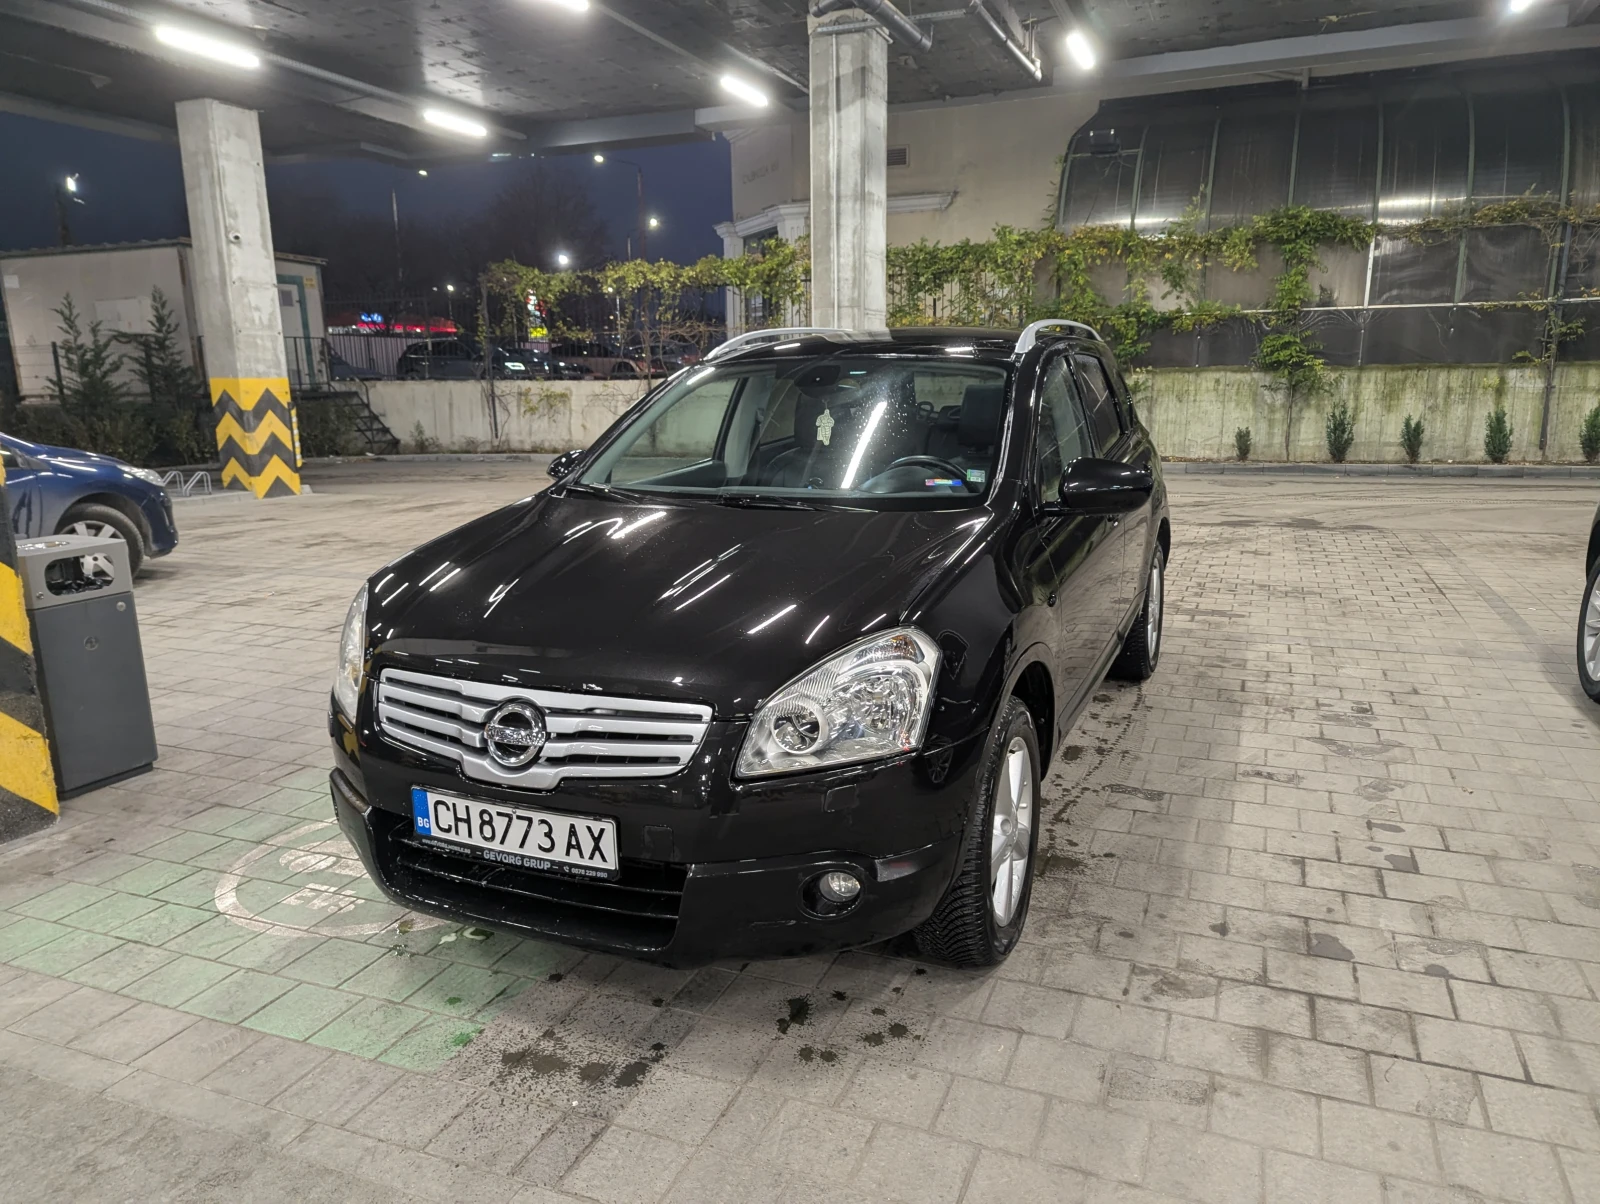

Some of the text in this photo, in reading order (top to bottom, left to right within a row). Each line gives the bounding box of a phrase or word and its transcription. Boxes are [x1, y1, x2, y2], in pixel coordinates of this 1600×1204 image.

[417, 816, 430, 829] BG
[433, 799, 608, 863] CH 8773 AX
[483, 850, 551, 870] GEVORG GRUP
